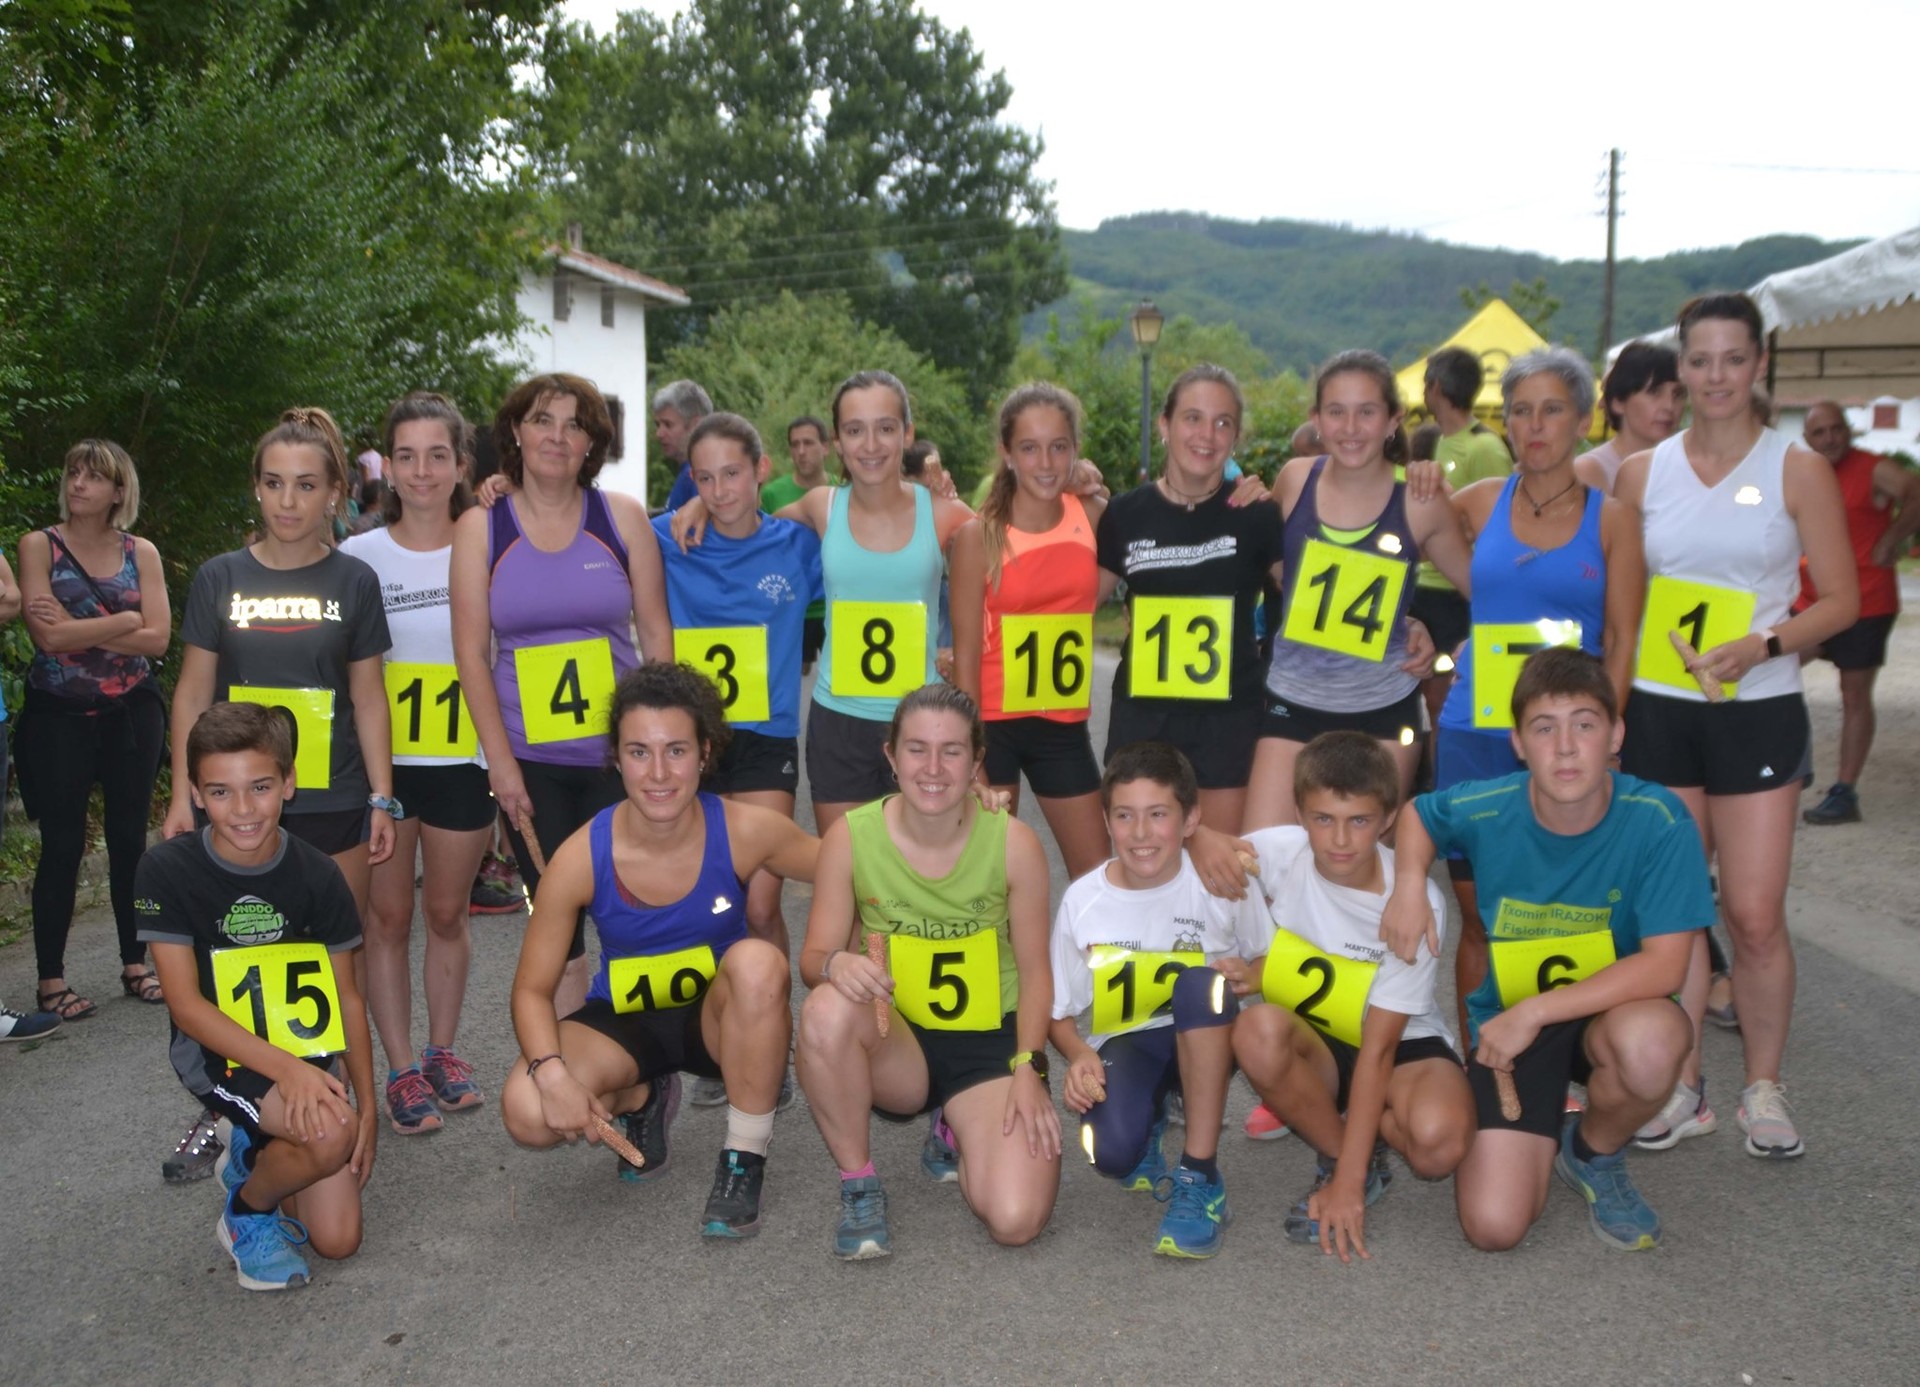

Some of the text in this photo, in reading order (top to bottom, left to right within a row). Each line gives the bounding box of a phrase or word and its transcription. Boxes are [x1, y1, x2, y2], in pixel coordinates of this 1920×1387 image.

[230, 593, 323, 628] iparra
[1308, 563, 1389, 645] 14
[1678, 601, 1710, 674] 1
[704, 643, 739, 710] 3
[861, 617, 896, 685] 8
[1014, 630, 1085, 698] 16
[1145, 614, 1221, 685] 13
[397, 677, 461, 744] 11
[550, 658, 590, 724] 4
[231, 904, 274, 914] ONDDO
[1504, 904, 1547, 920] Txomin
[232, 960, 331, 1043] 15
[928, 951, 970, 1022] 5
[1108, 961, 1188, 1024] 12
[1295, 956, 1336, 1028] 2
